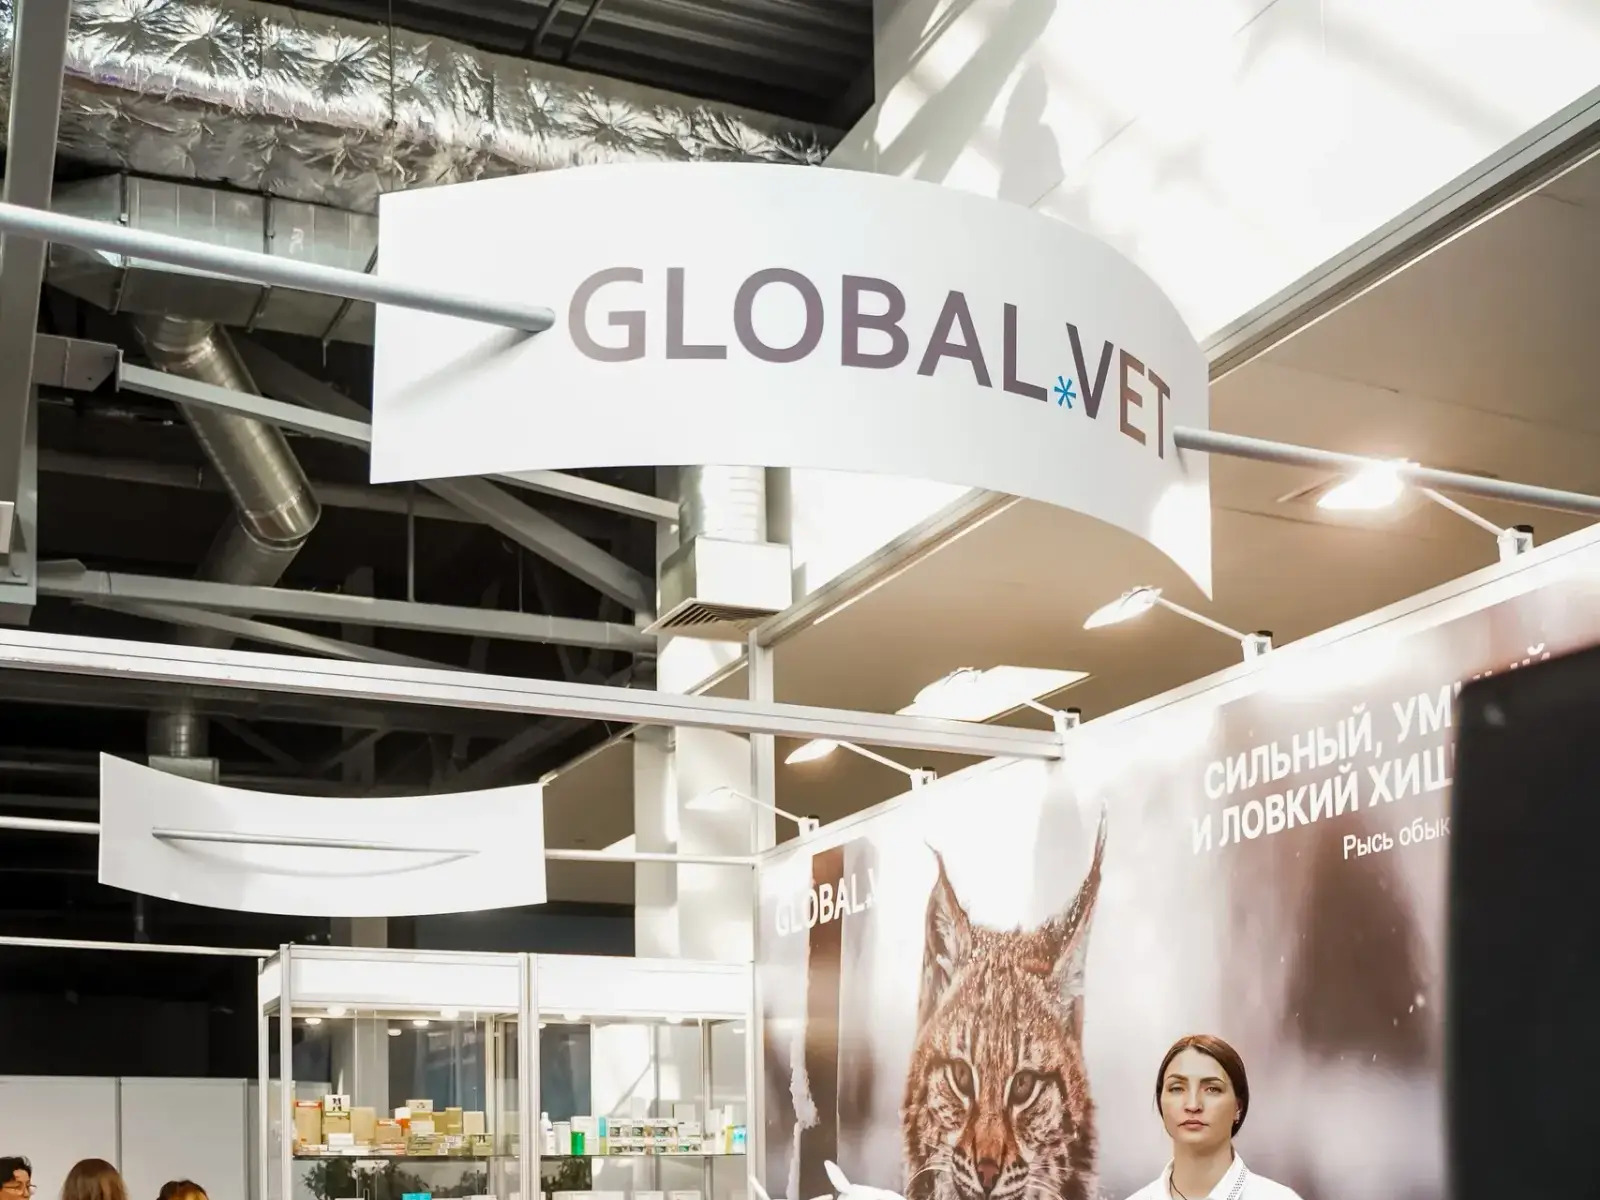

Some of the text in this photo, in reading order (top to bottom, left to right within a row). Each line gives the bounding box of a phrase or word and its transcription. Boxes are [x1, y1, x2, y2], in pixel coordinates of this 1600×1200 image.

[1203, 702, 1382, 800] СИЛЬНЫЙ,
[1193, 813, 1212, 855] И
[1219, 762, 1359, 848] ЛОВКИЙ
[1343, 815, 1451, 859] Рысь обык
